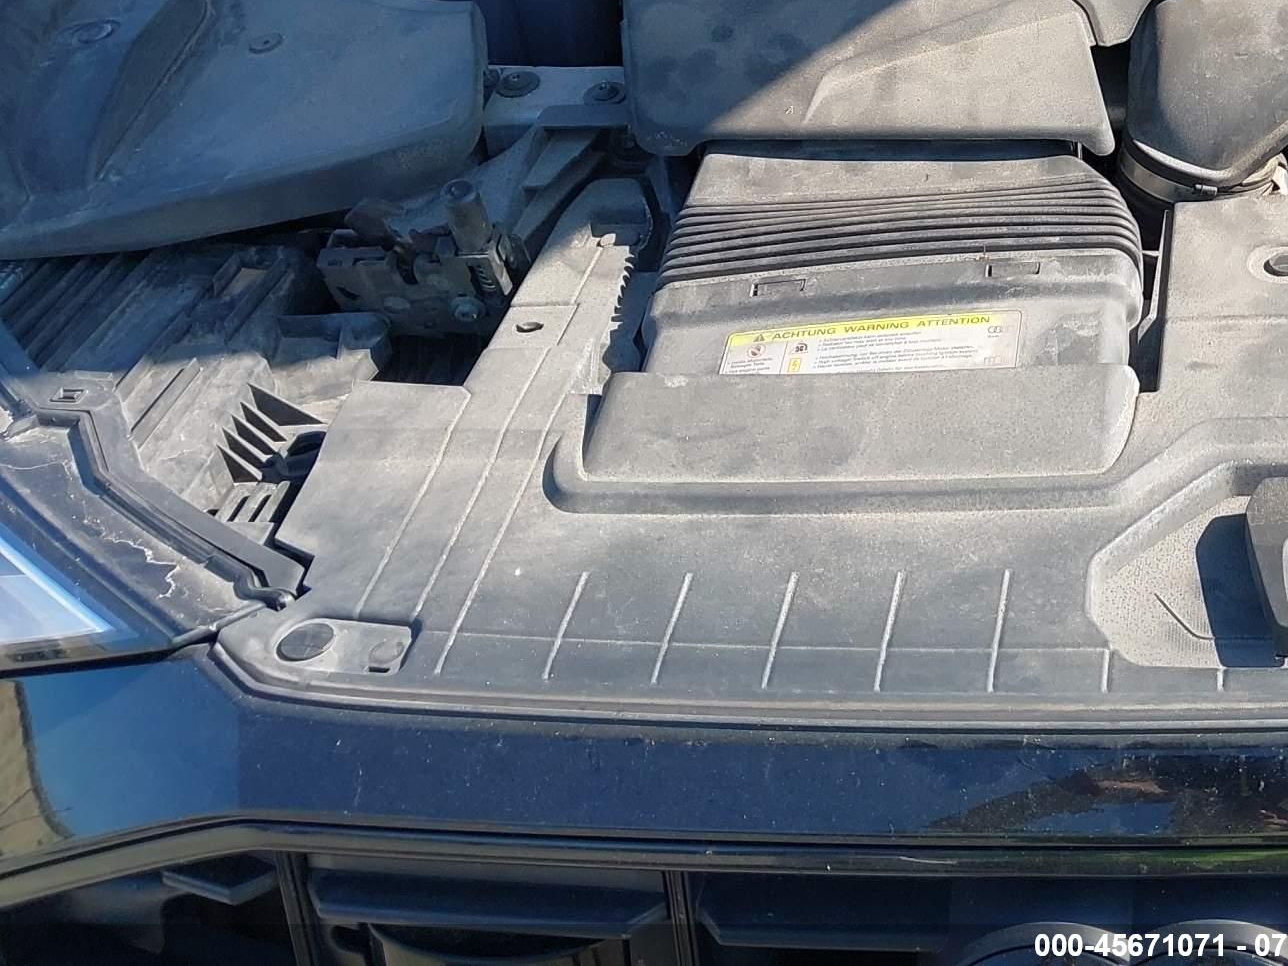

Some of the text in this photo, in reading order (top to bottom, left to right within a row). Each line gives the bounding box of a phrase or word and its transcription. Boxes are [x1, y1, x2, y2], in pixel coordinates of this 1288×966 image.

[772, 328, 836, 340] ACHTUNG
[844, 322, 909, 333] WARNING
[917, 316, 990, 327] ATTENTION
